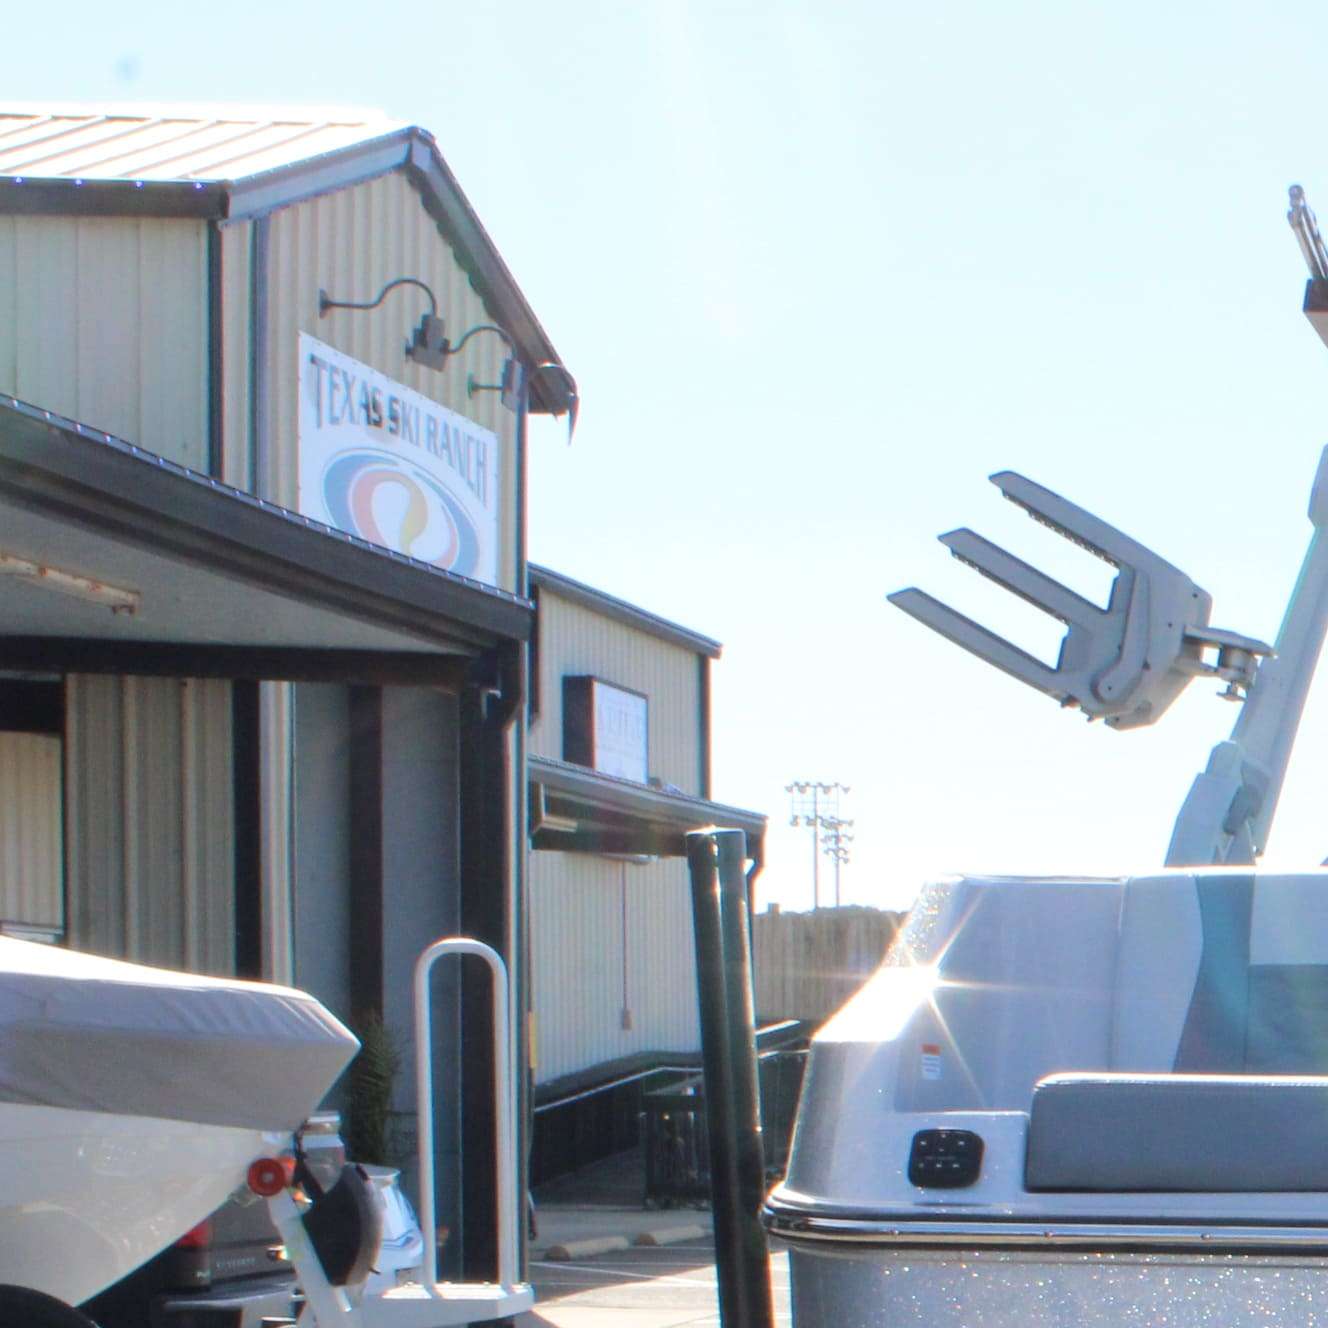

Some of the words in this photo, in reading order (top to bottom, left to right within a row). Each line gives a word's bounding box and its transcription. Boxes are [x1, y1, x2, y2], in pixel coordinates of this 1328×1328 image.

[310, 352, 383, 430] TEXAS
[388, 395, 422, 449] SKI
[425, 412, 488, 509] RANCH
